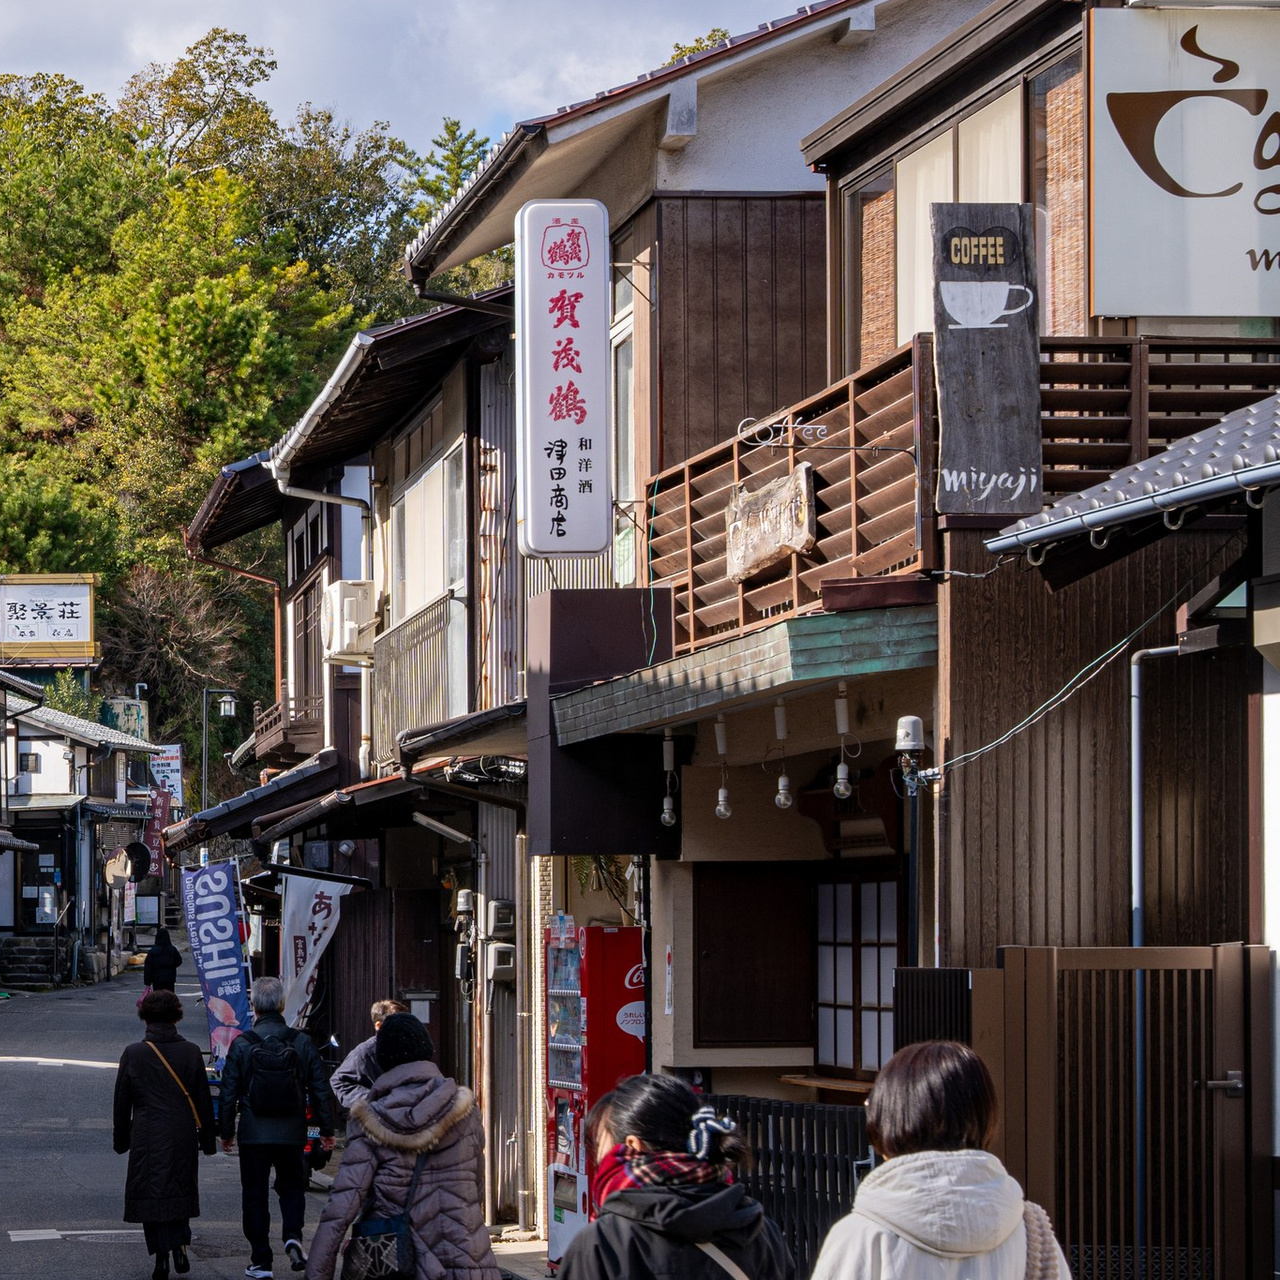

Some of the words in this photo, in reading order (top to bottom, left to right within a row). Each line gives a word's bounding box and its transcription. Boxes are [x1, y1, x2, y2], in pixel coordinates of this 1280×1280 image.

[950, 236, 1005, 265] COFFEE
[548, 288, 587, 426] 賀茂鶴
[543, 439, 569, 538] 津田商店
[578, 437, 593, 494] 和洋酒
[940, 467, 1037, 503] miyaji
[6, 601, 82, 620] 聚景荘
